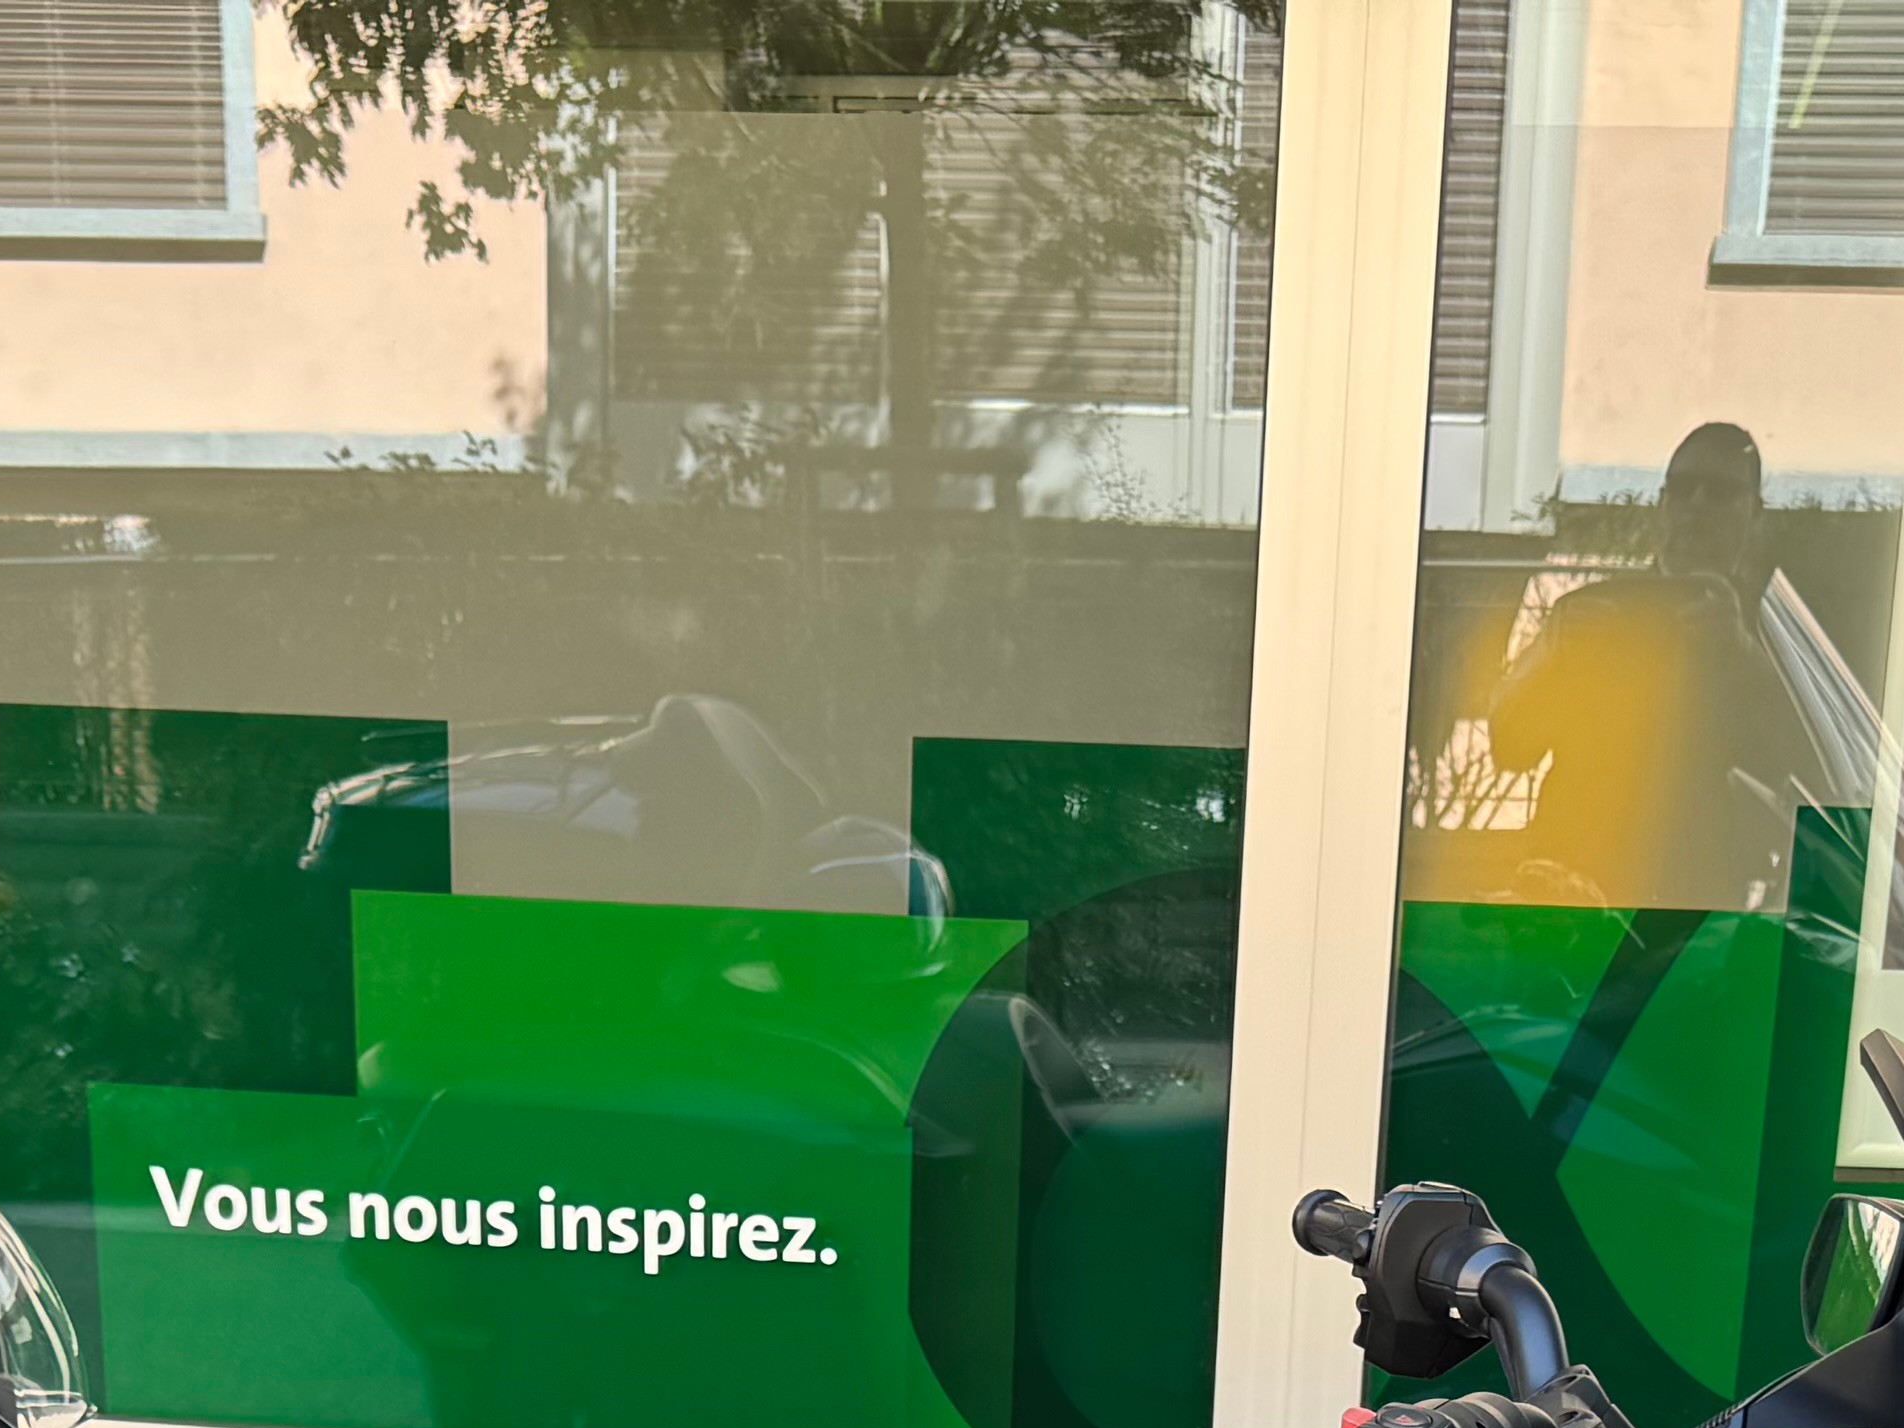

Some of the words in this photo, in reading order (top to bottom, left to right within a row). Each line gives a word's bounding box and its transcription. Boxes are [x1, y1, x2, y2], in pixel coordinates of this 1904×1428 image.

[149, 1165, 328, 1236] Vous
[348, 1190, 519, 1249] nous
[538, 1185, 839, 1276] inspirez.
